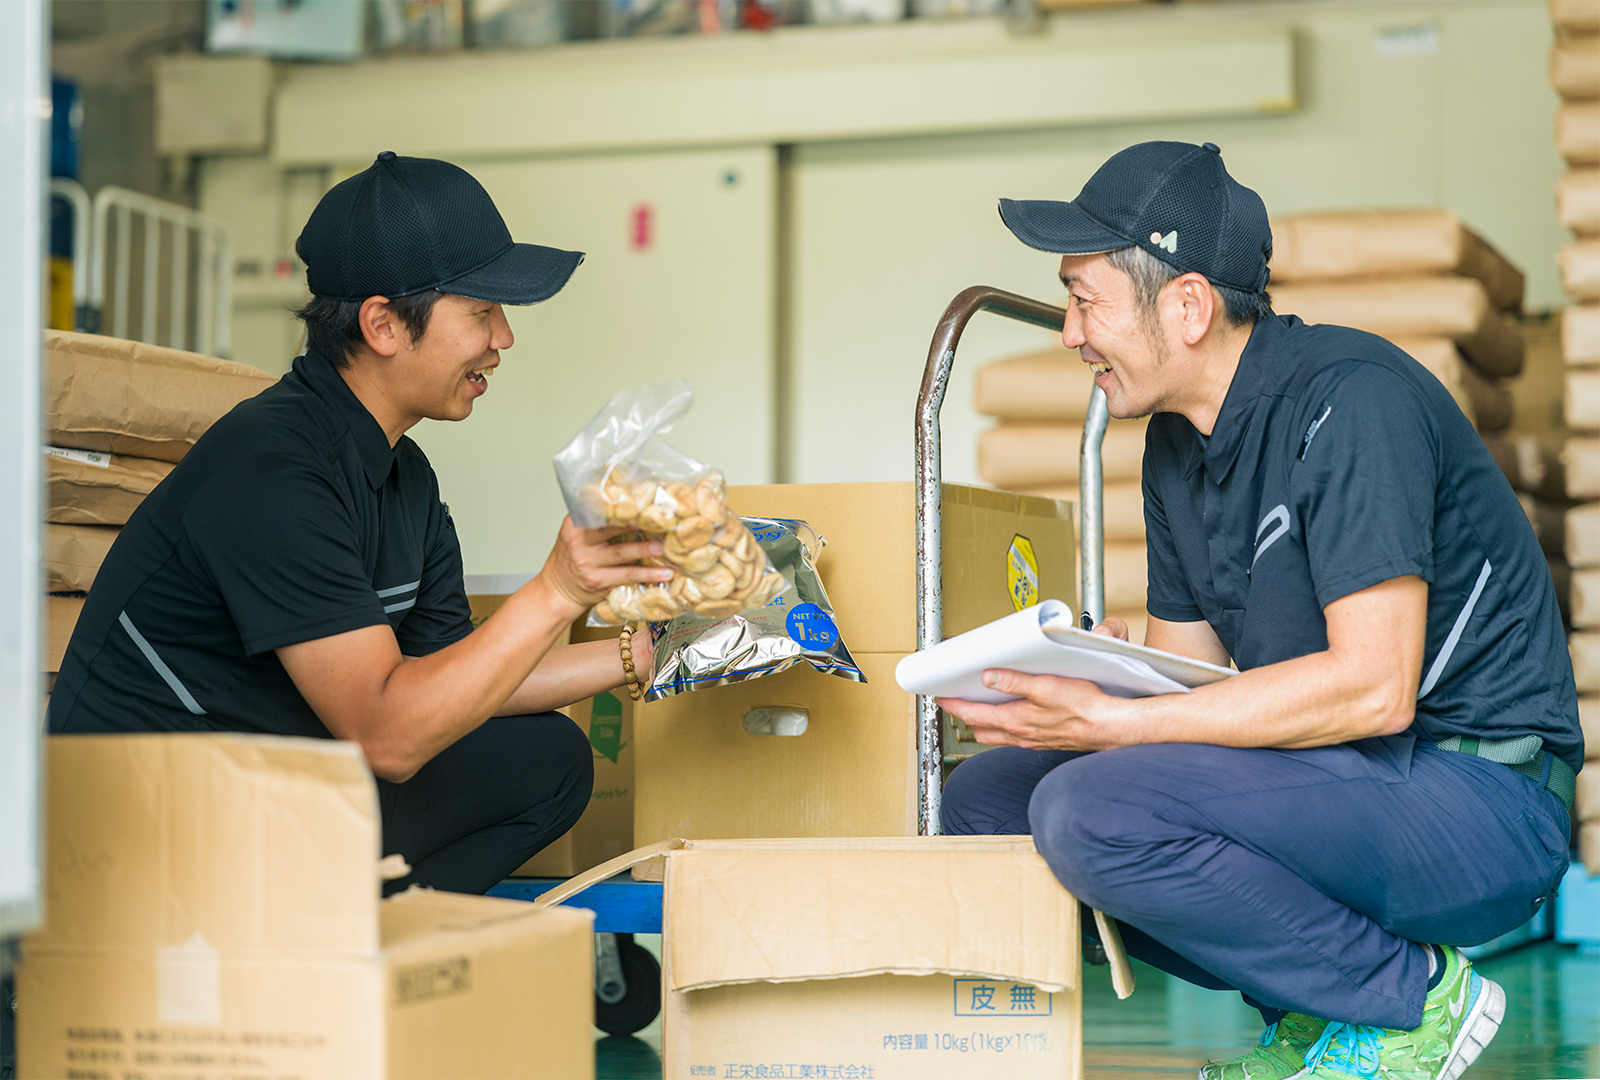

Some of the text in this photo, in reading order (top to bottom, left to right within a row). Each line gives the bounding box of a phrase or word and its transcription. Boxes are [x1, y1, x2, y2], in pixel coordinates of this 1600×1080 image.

[792, 612, 829, 621] NET WT.
[794, 622, 830, 644] 1kg
[883, 1033, 929, 1050] 内容量
[723, 1063, 875, 1080] 正栄食品工業株式会社
